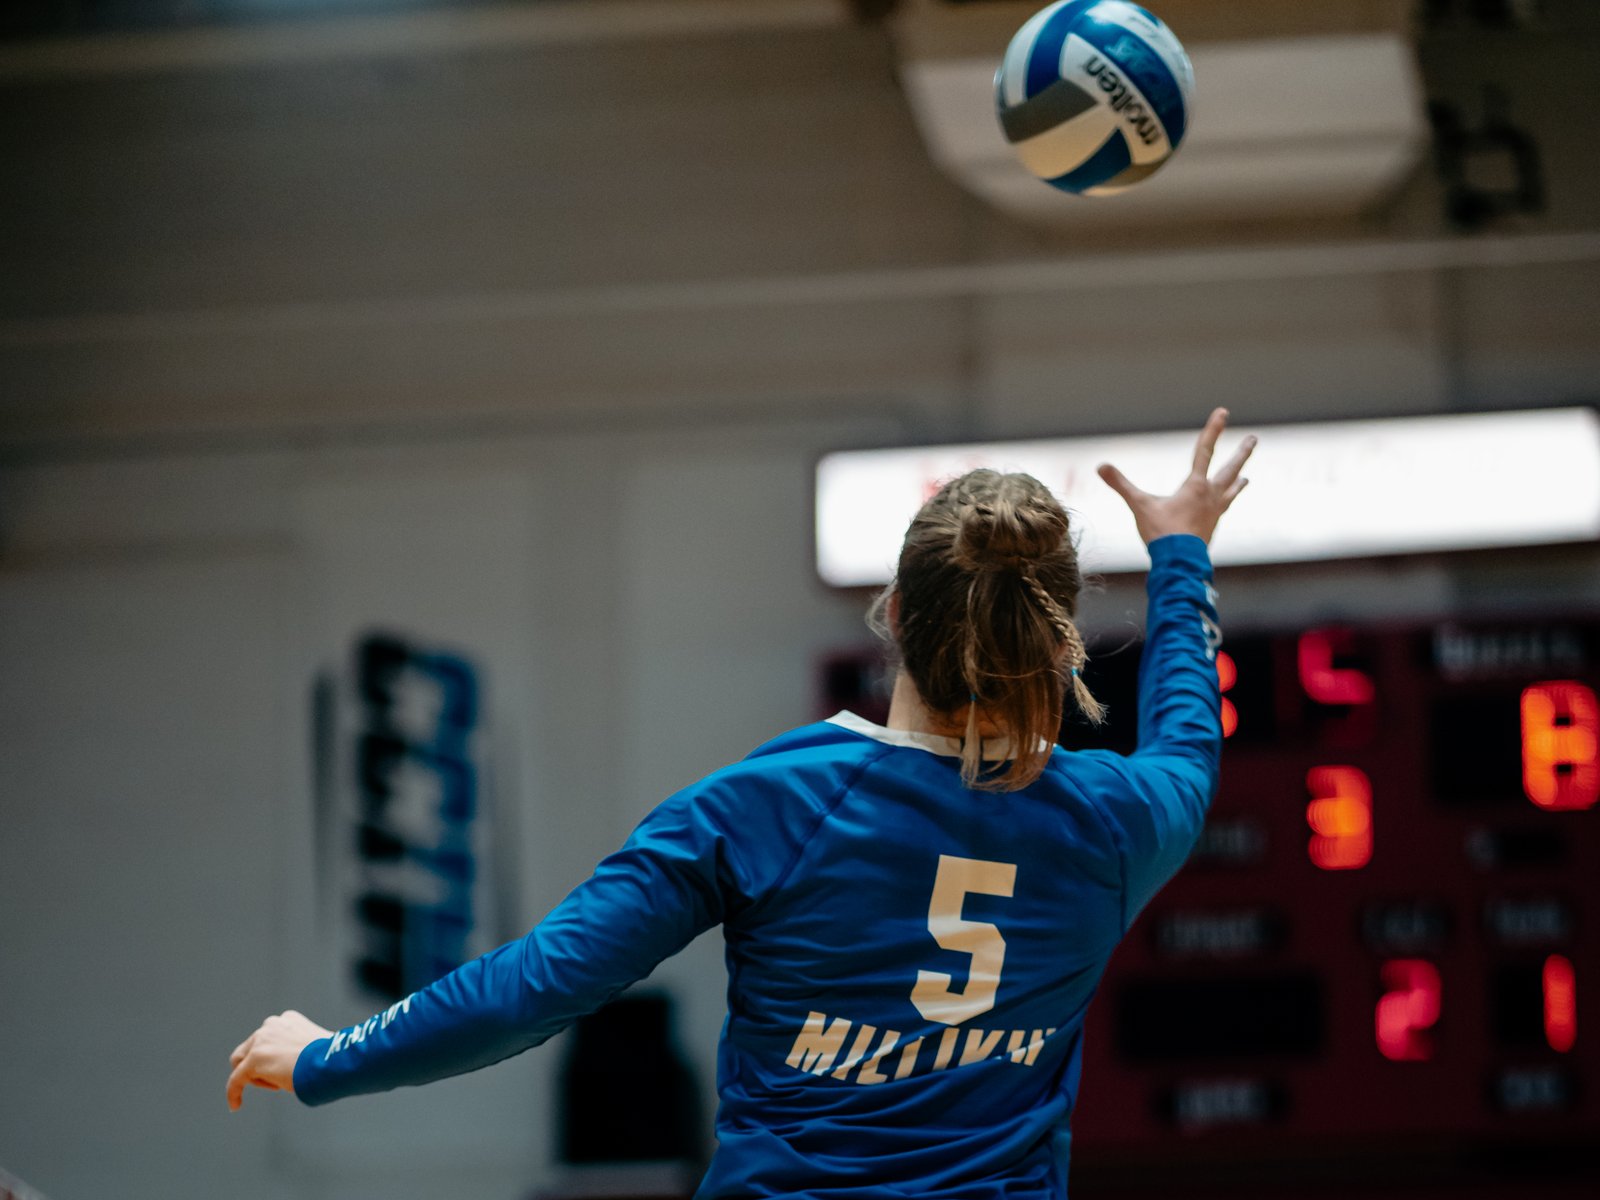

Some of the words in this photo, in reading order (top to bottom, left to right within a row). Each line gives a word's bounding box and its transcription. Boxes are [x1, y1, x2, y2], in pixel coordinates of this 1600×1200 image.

[1083, 54, 1162, 146] molten
[1306, 764, 1374, 870] 3
[910, 854, 1017, 1026] 5
[1375, 958, 1441, 1061] 2
[1542, 953, 1577, 1053] 1
